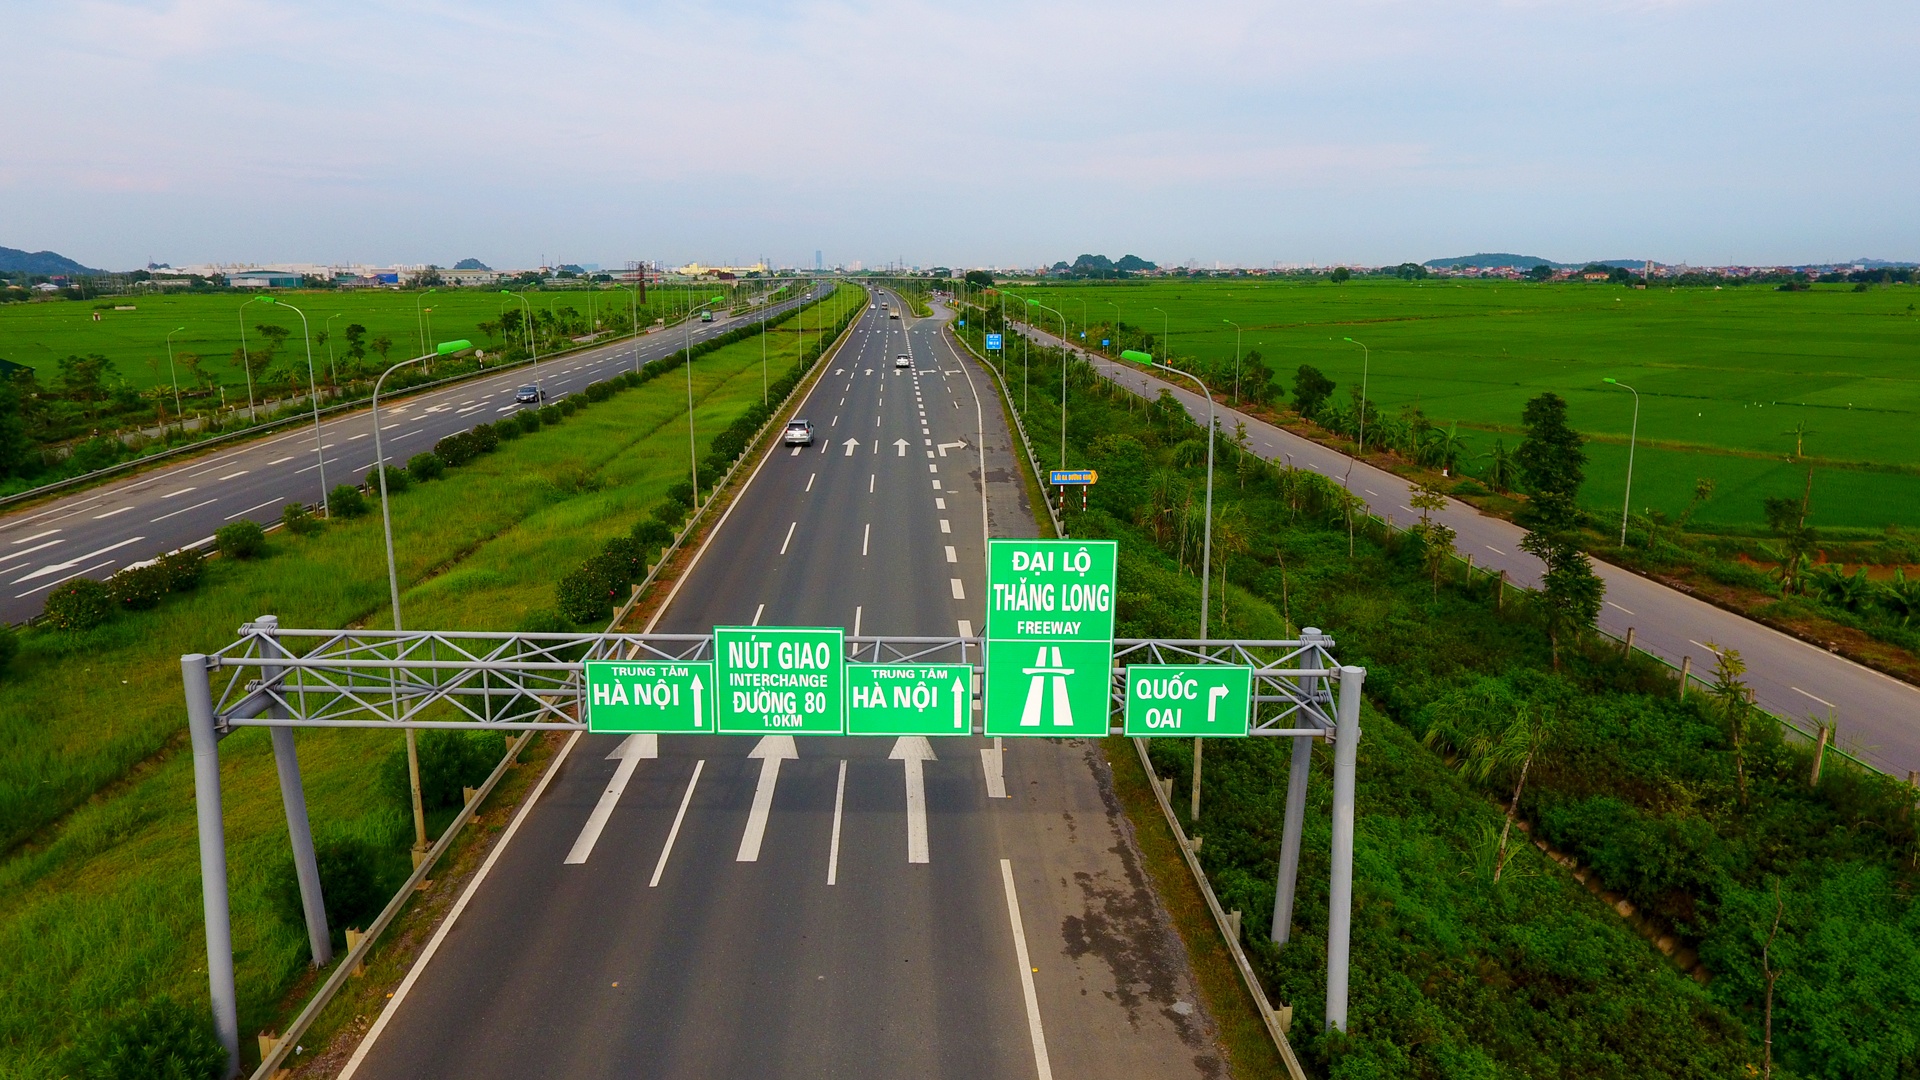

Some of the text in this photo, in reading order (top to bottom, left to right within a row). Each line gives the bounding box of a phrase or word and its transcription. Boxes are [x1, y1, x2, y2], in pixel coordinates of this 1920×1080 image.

[1012, 546, 1092, 577] ĐẠI LỘ
[993, 577, 1110, 612] THĂNG LONG
[1017, 620, 1082, 635] FREEWAY
[728, 634, 831, 670] NÚT GIAO
[611, 665, 689, 677] TRUNG TÂM
[729, 672, 828, 688] INTERCHANGE
[871, 667, 949, 680] TRUNG TÂM
[593, 678, 679, 711] HÀ NỘI
[852, 680, 938, 713] HÀ NỘI
[1136, 671, 1198, 700] QUỐC
[732, 687, 827, 714] ĐƯỜNG 80
[762, 714, 803, 728] 1.0KM
[1145, 707, 1182, 729] OAI
